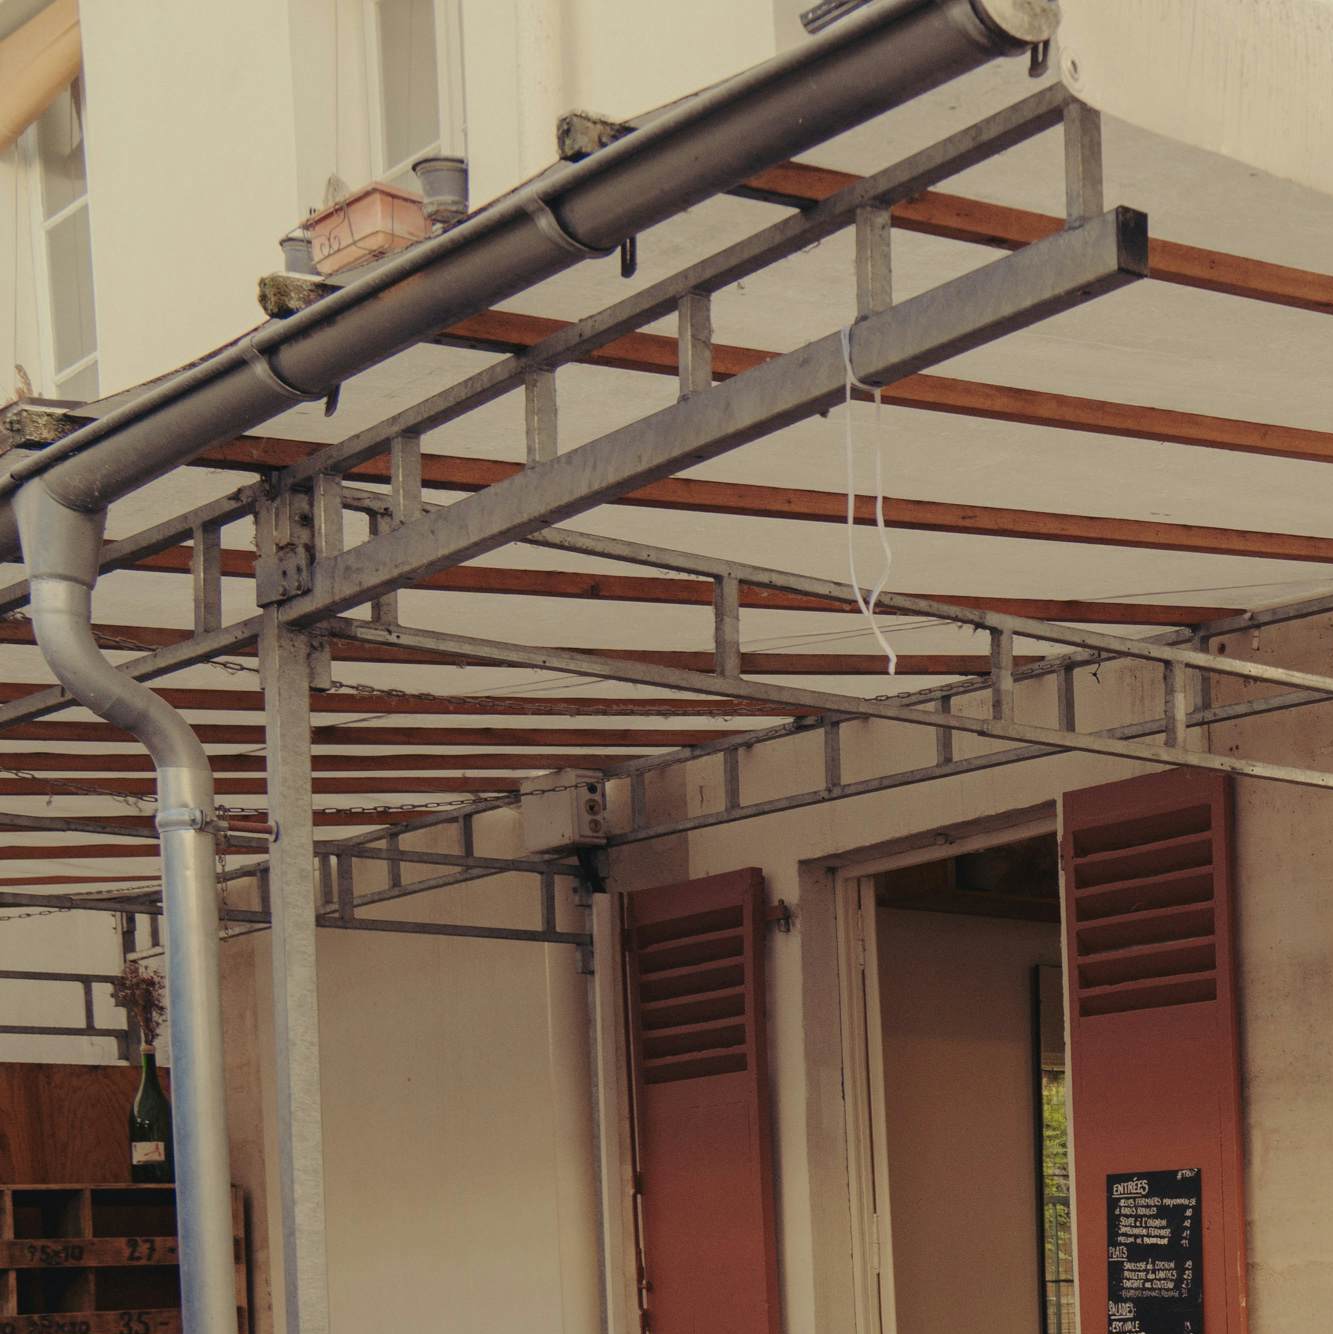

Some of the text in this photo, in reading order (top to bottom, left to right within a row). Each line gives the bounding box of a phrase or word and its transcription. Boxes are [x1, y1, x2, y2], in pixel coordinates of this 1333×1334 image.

[1112, 1177, 1149, 1195] ENTRÉES
[126, 1237, 156, 1262] 27
[1108, 1246, 1128, 1258] PLATS
